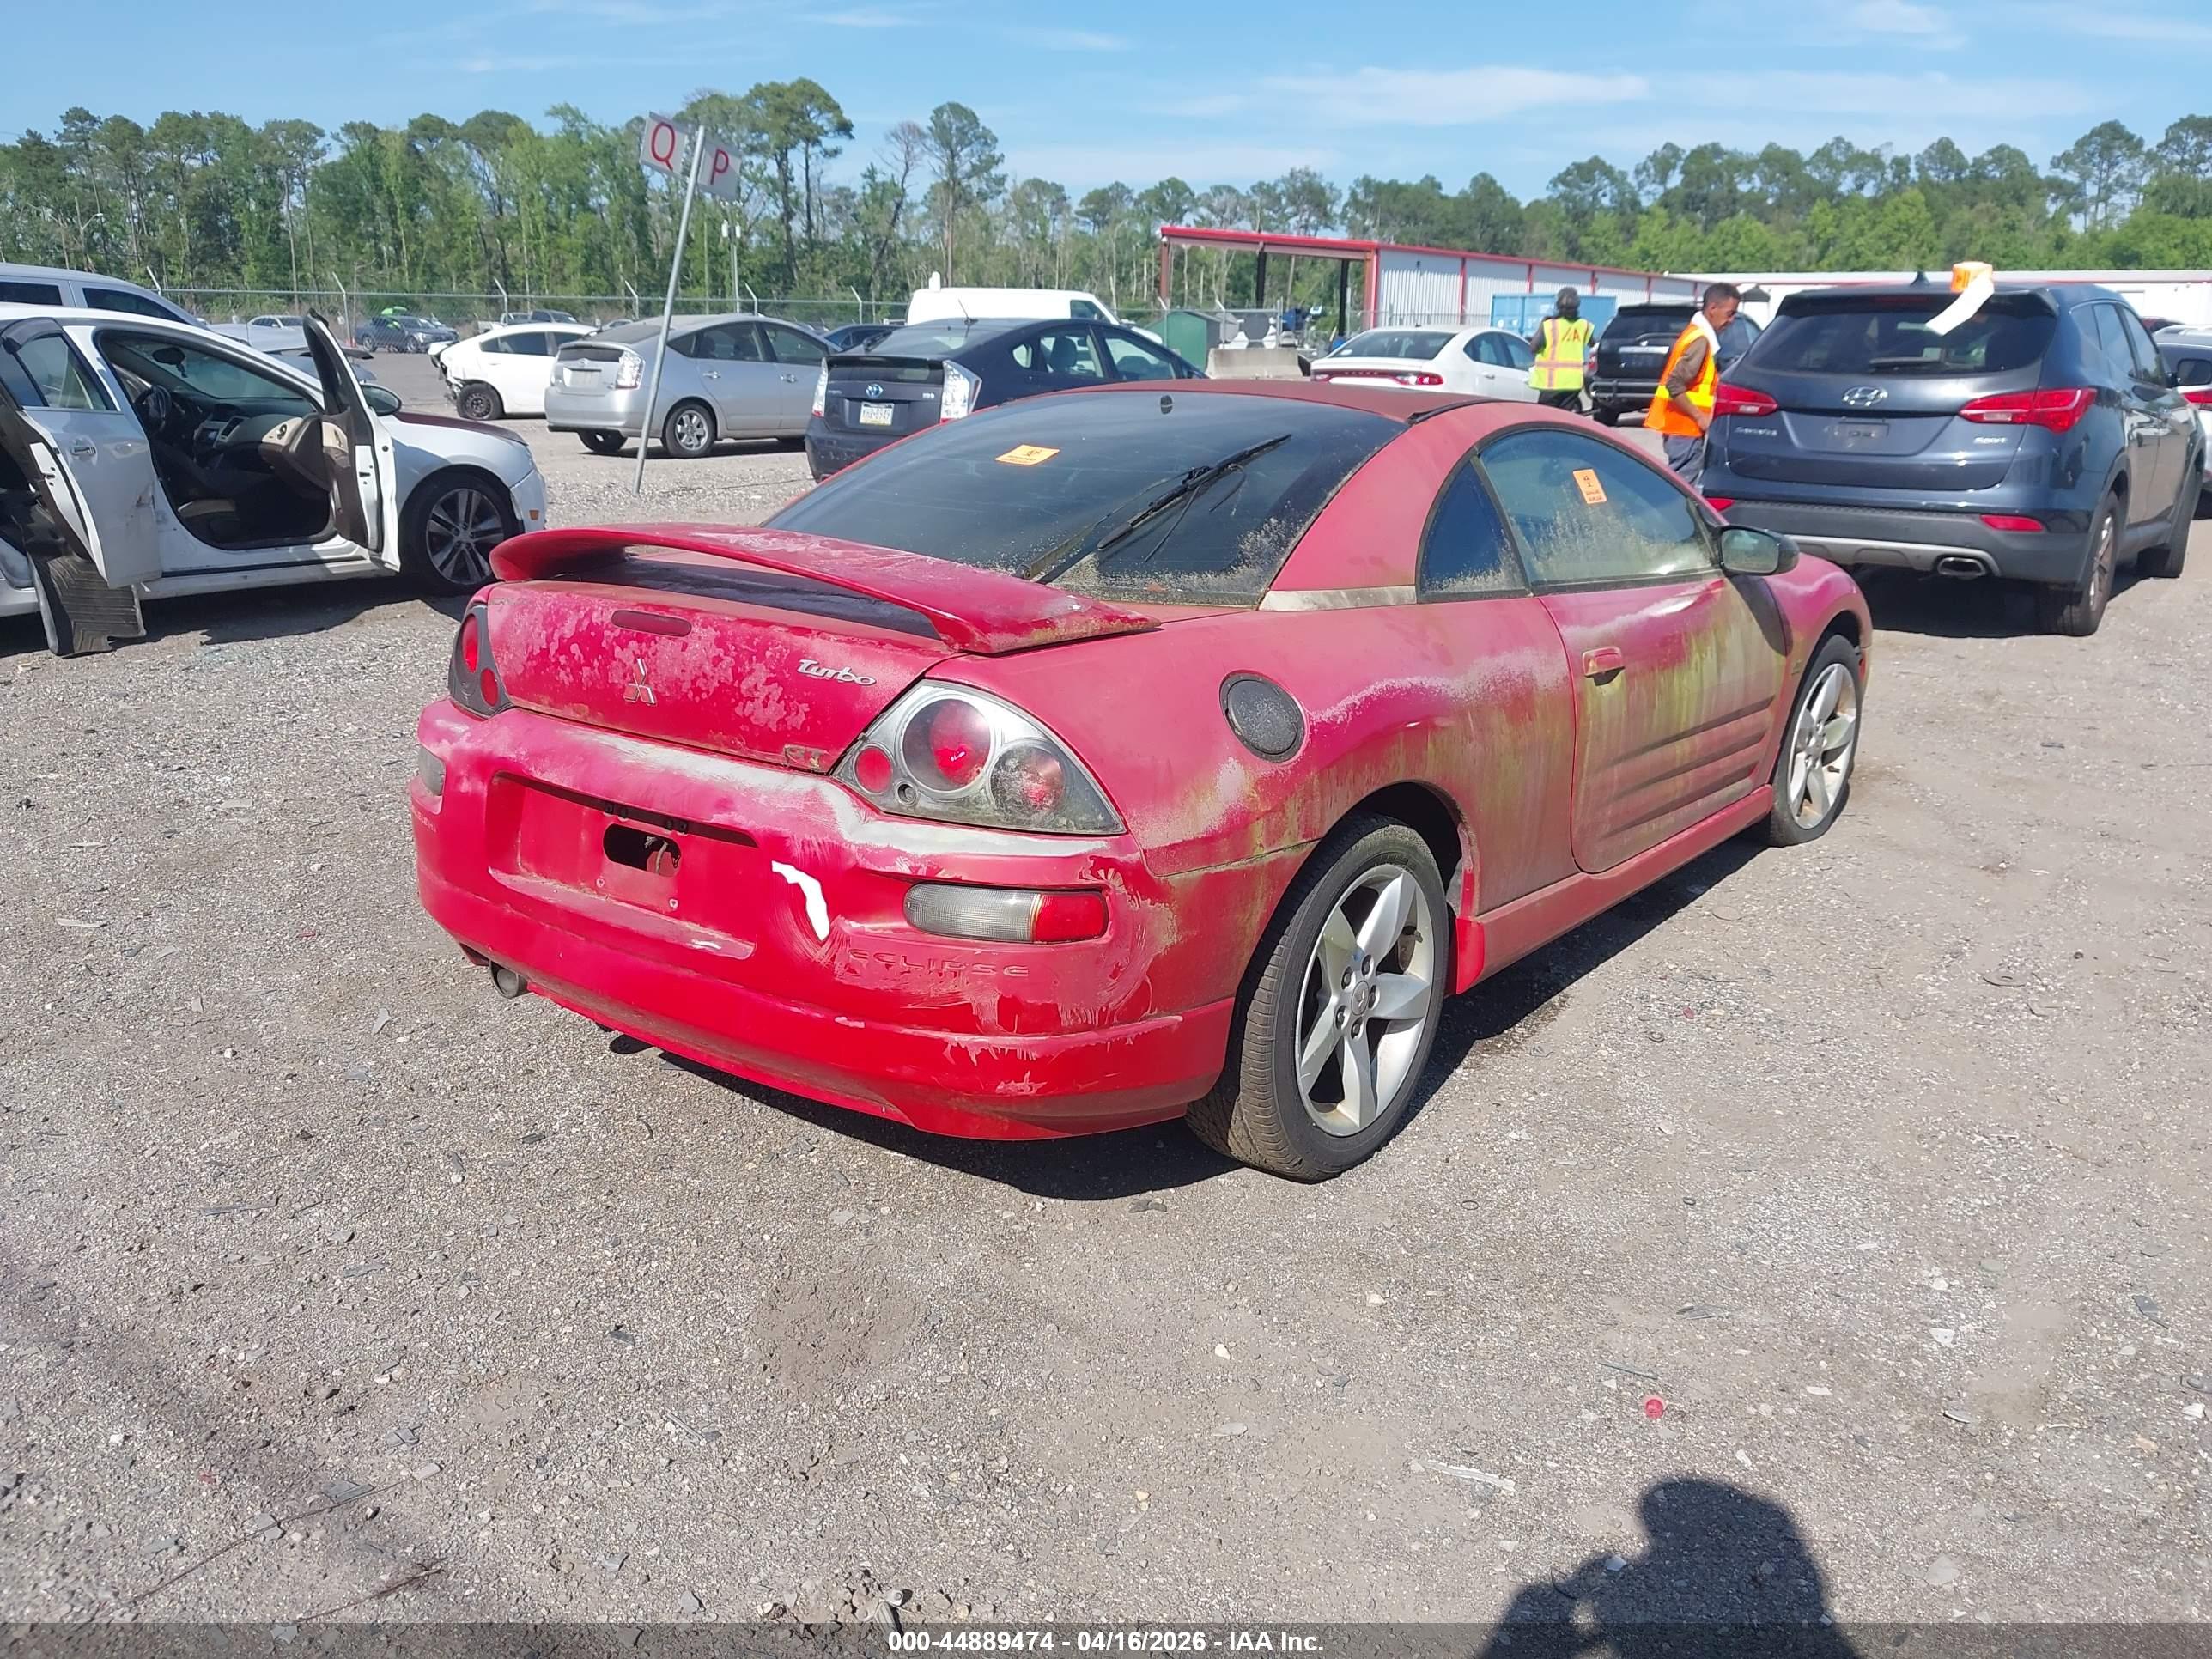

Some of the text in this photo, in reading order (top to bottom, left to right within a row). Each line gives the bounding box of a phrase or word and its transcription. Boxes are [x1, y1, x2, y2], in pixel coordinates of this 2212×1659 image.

[651, 122, 675, 171] Q
[710, 148, 729, 185] P
[797, 659, 877, 686] Turbo
[848, 948, 1029, 978] ECLIPSE
